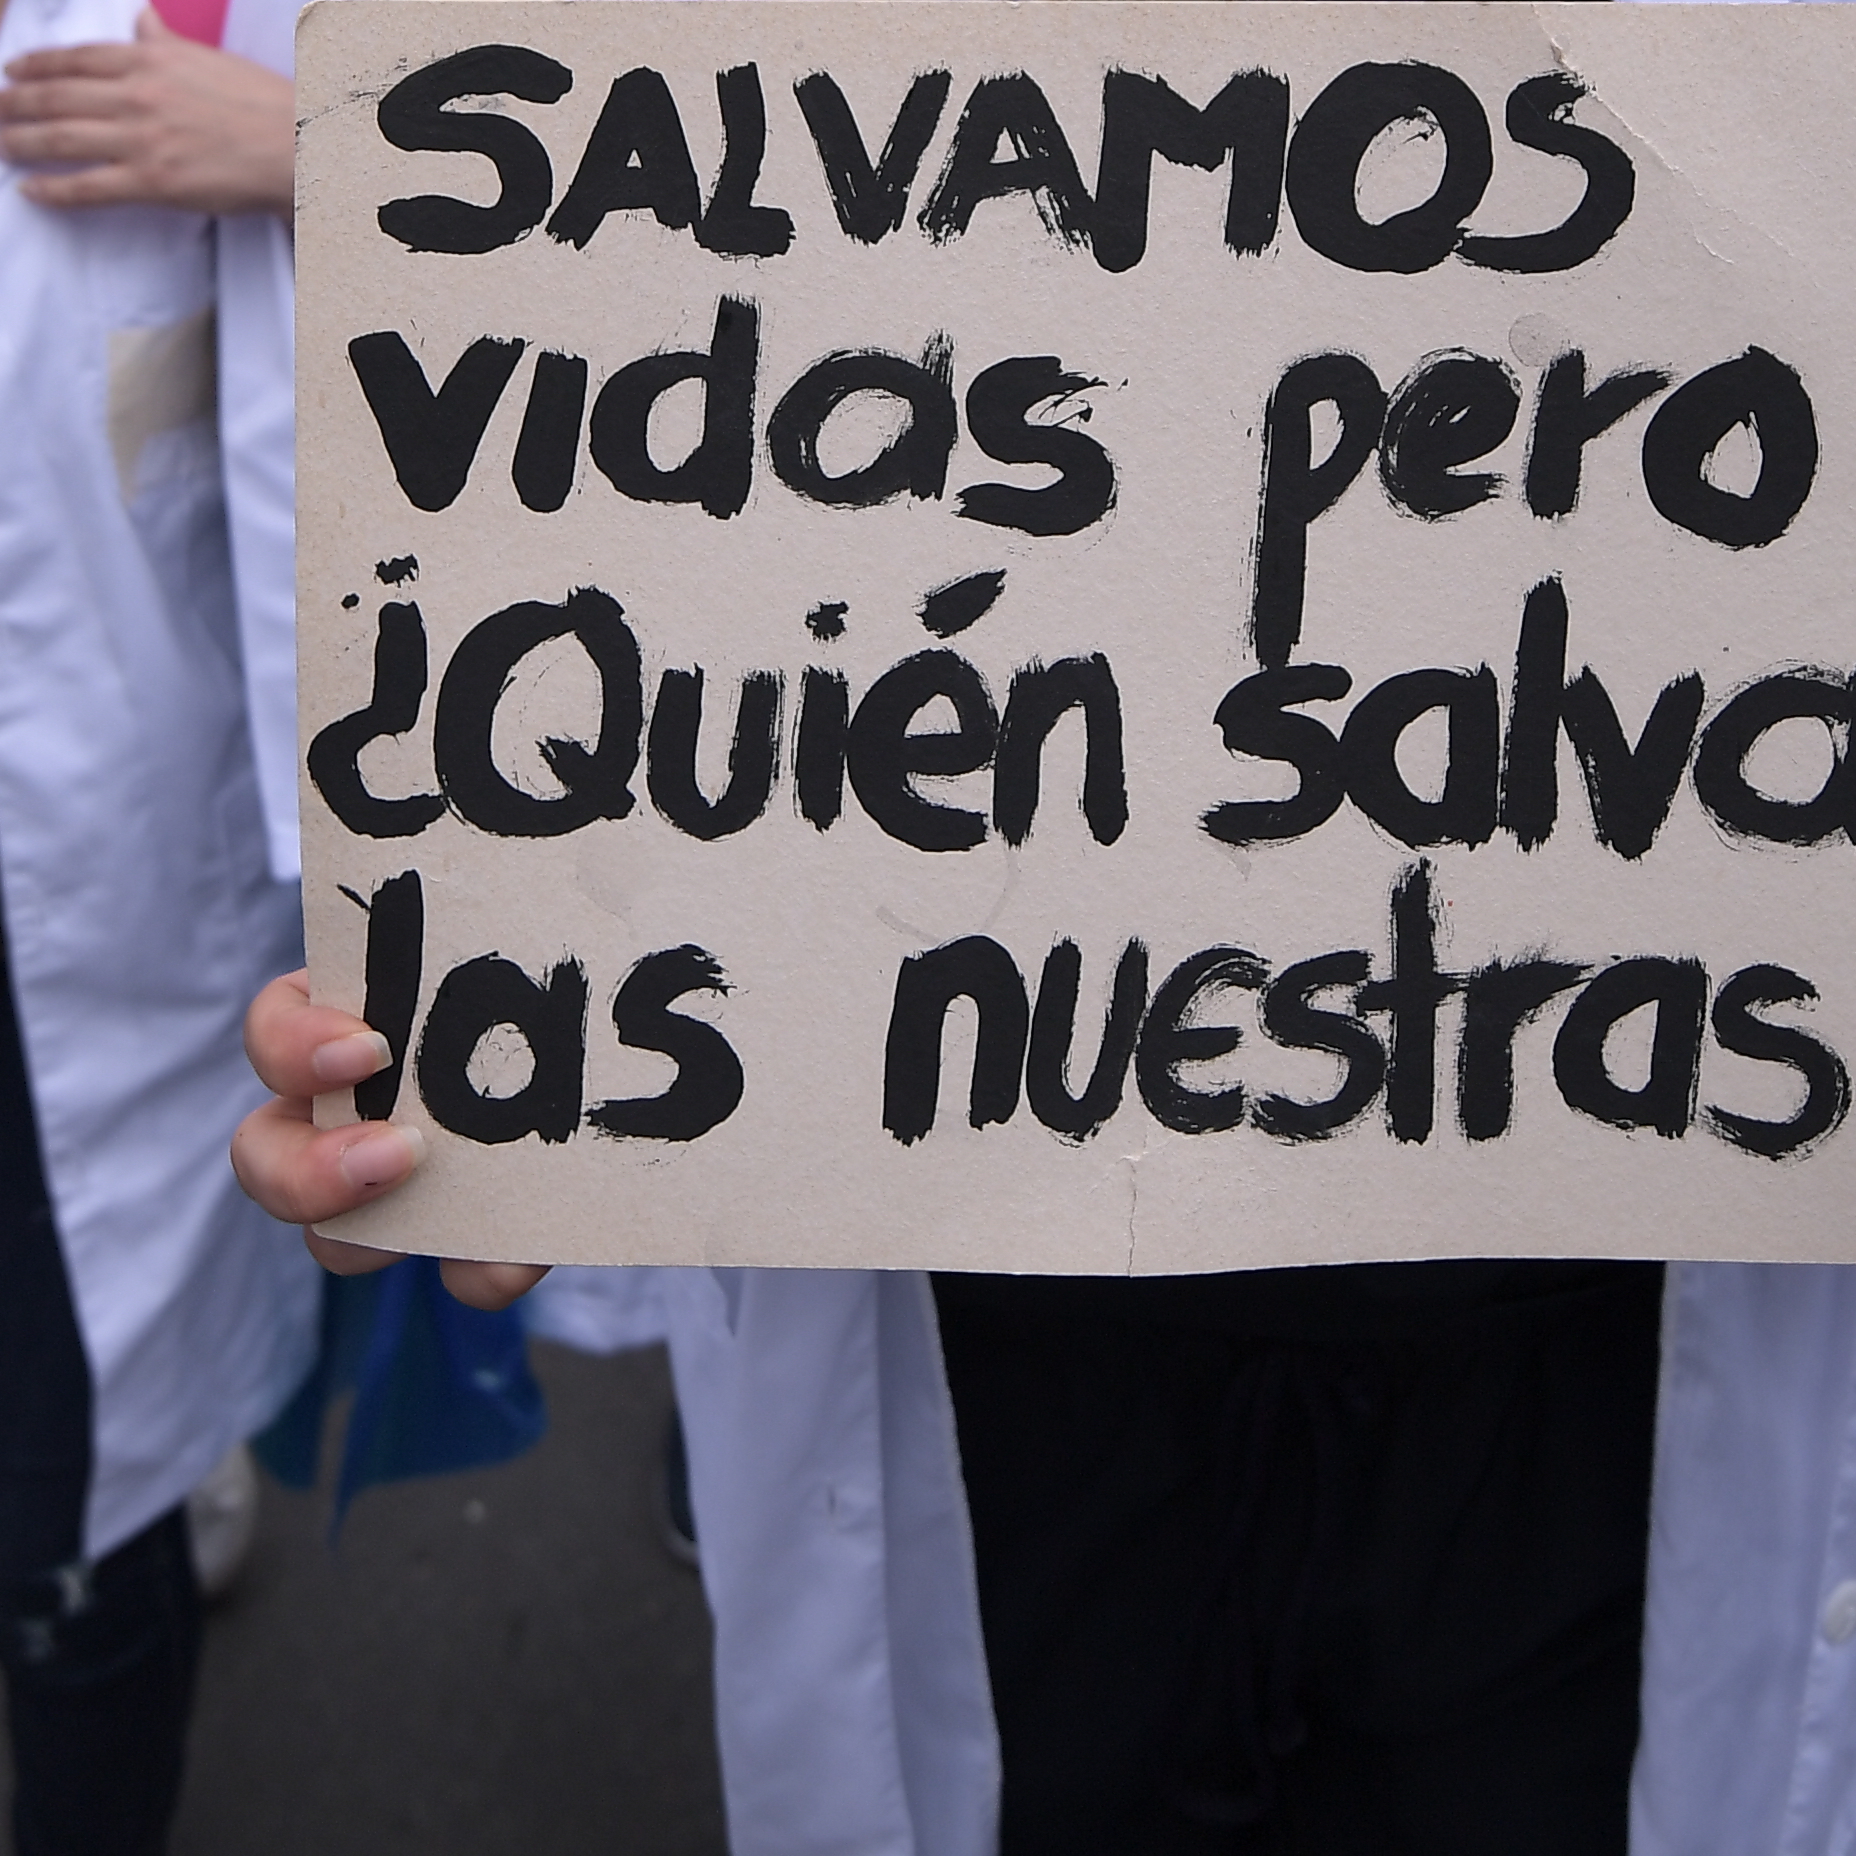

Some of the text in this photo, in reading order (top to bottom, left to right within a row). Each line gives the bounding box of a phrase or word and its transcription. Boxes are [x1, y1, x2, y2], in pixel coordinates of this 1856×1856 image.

[374, 42, 1638, 277] SALVAMOS
[346, 292, 1821, 668] vidas pero
[305, 552, 1131, 854] ¿Quién
[336, 866, 747, 1147] las
